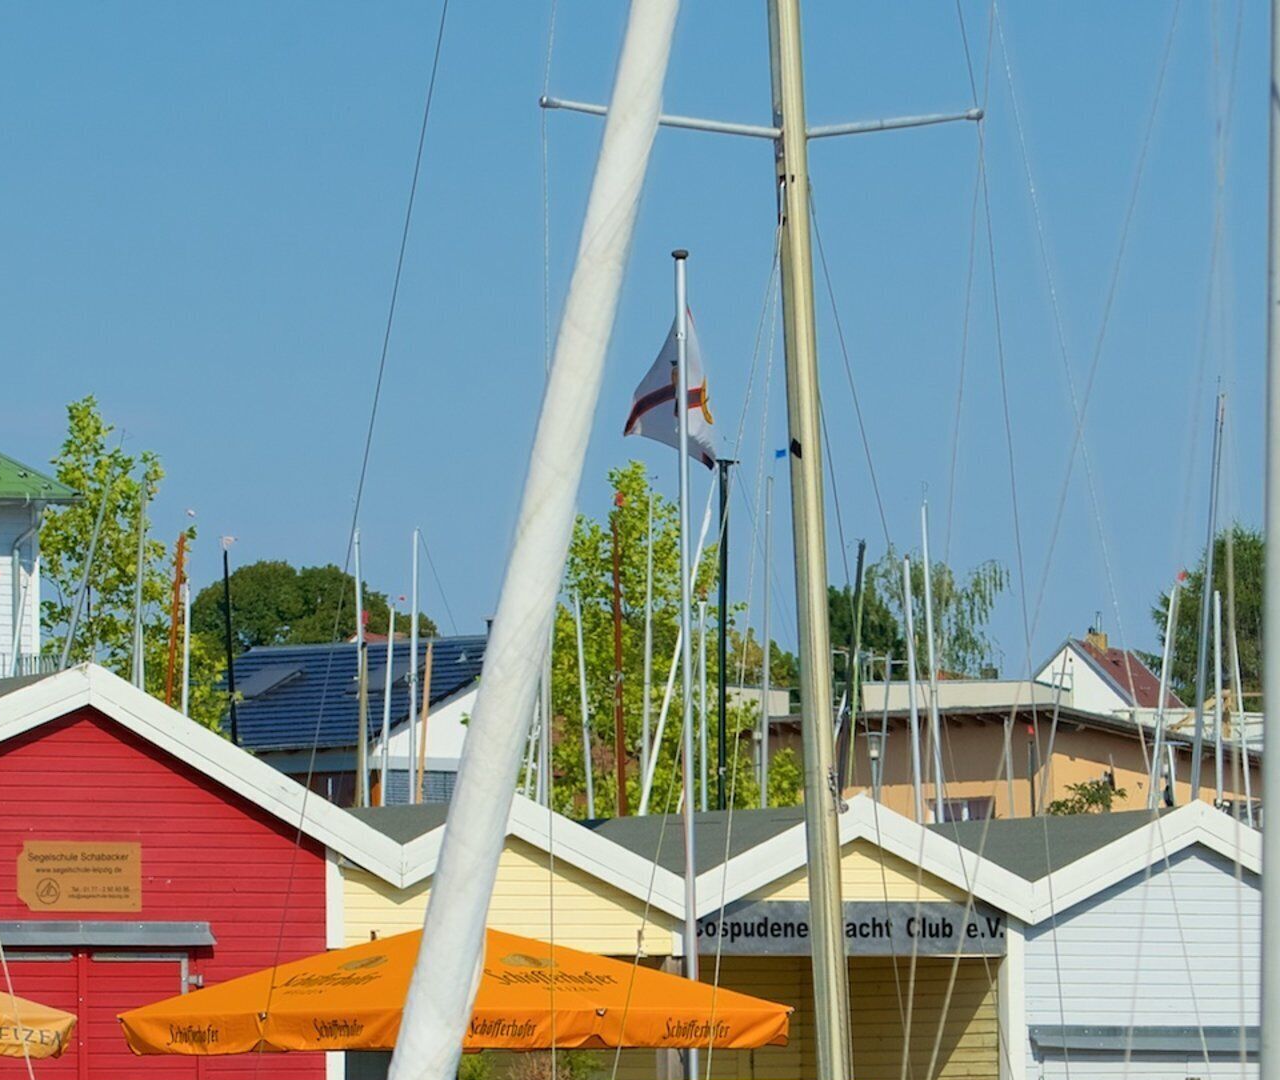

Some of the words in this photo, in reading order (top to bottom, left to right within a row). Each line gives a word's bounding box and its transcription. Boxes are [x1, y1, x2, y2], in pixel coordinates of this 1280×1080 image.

[27, 852, 78, 863] Segelschule
[80, 852, 129, 862] Schabacker
[845, 915, 891, 937] acht
[906, 915, 953, 938] Club
[966, 916, 1005, 938] e.V.
[483, 968, 619, 987] Schöfferhofer
[468, 1015, 538, 1039] Schöfferhofer
[662, 1016, 731, 1040] Schöfferhofer
